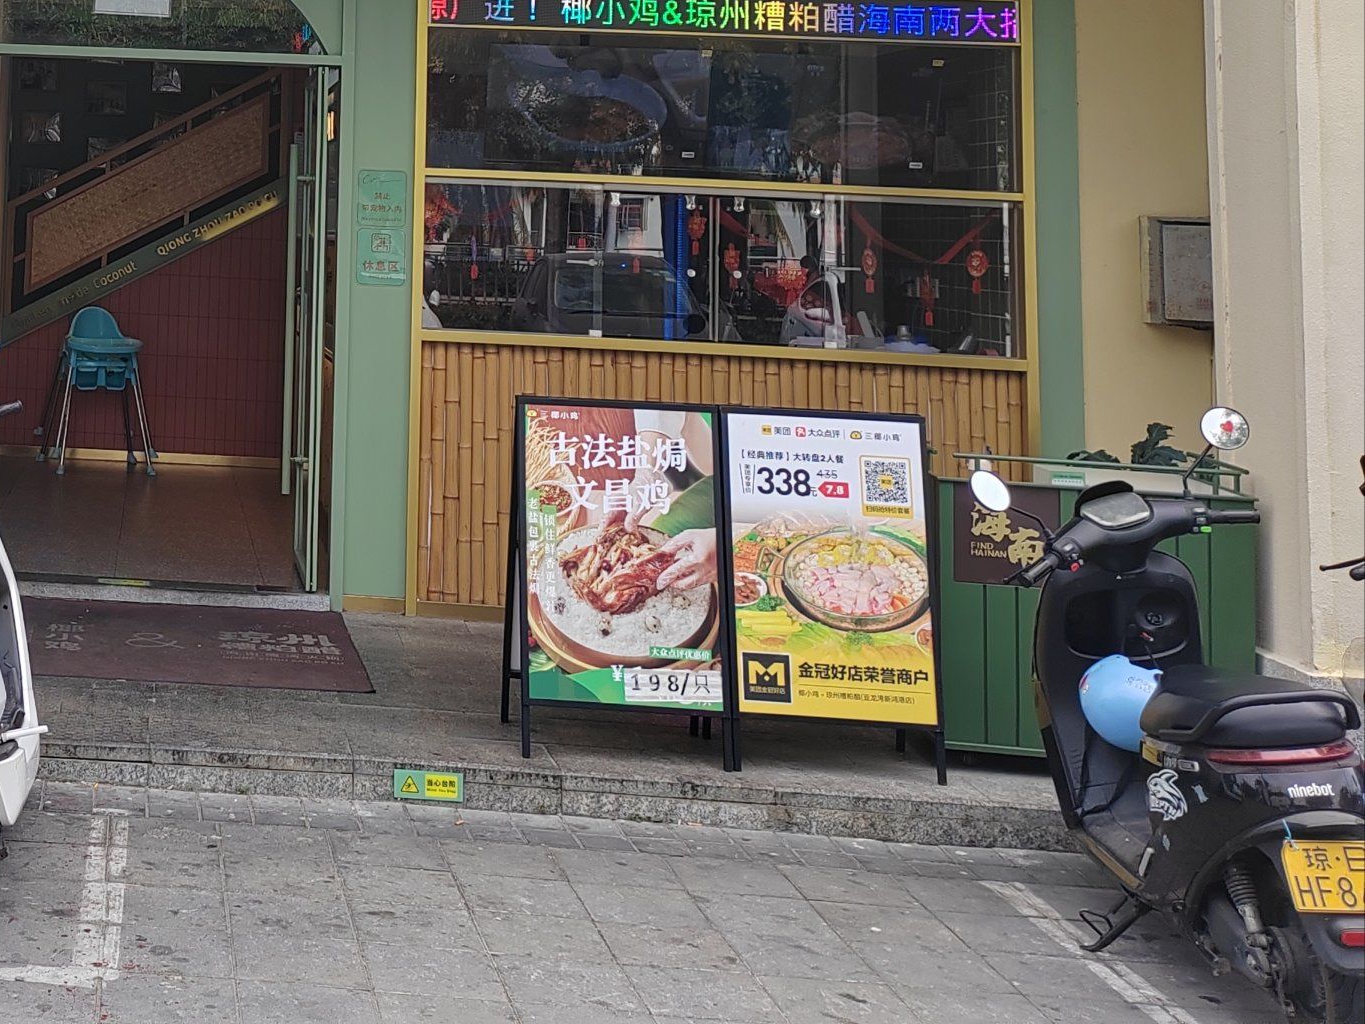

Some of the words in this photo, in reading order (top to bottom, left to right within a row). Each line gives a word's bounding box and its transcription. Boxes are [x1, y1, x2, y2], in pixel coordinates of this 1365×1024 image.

[156, 232, 192, 257] QIONG
[362, 260, 399, 272] 休息区
[547, 431, 688, 473] 古法盐焗
[564, 475, 672, 515] 文昌鸡
[970, 541, 994, 550] FIND
[970, 548, 1008, 558] HAINAN
[798, 662, 930, 686] 金冠好店荣誉商户
[1287, 782, 1335, 799] ninebot
[1293, 875, 1365, 908] HF8
